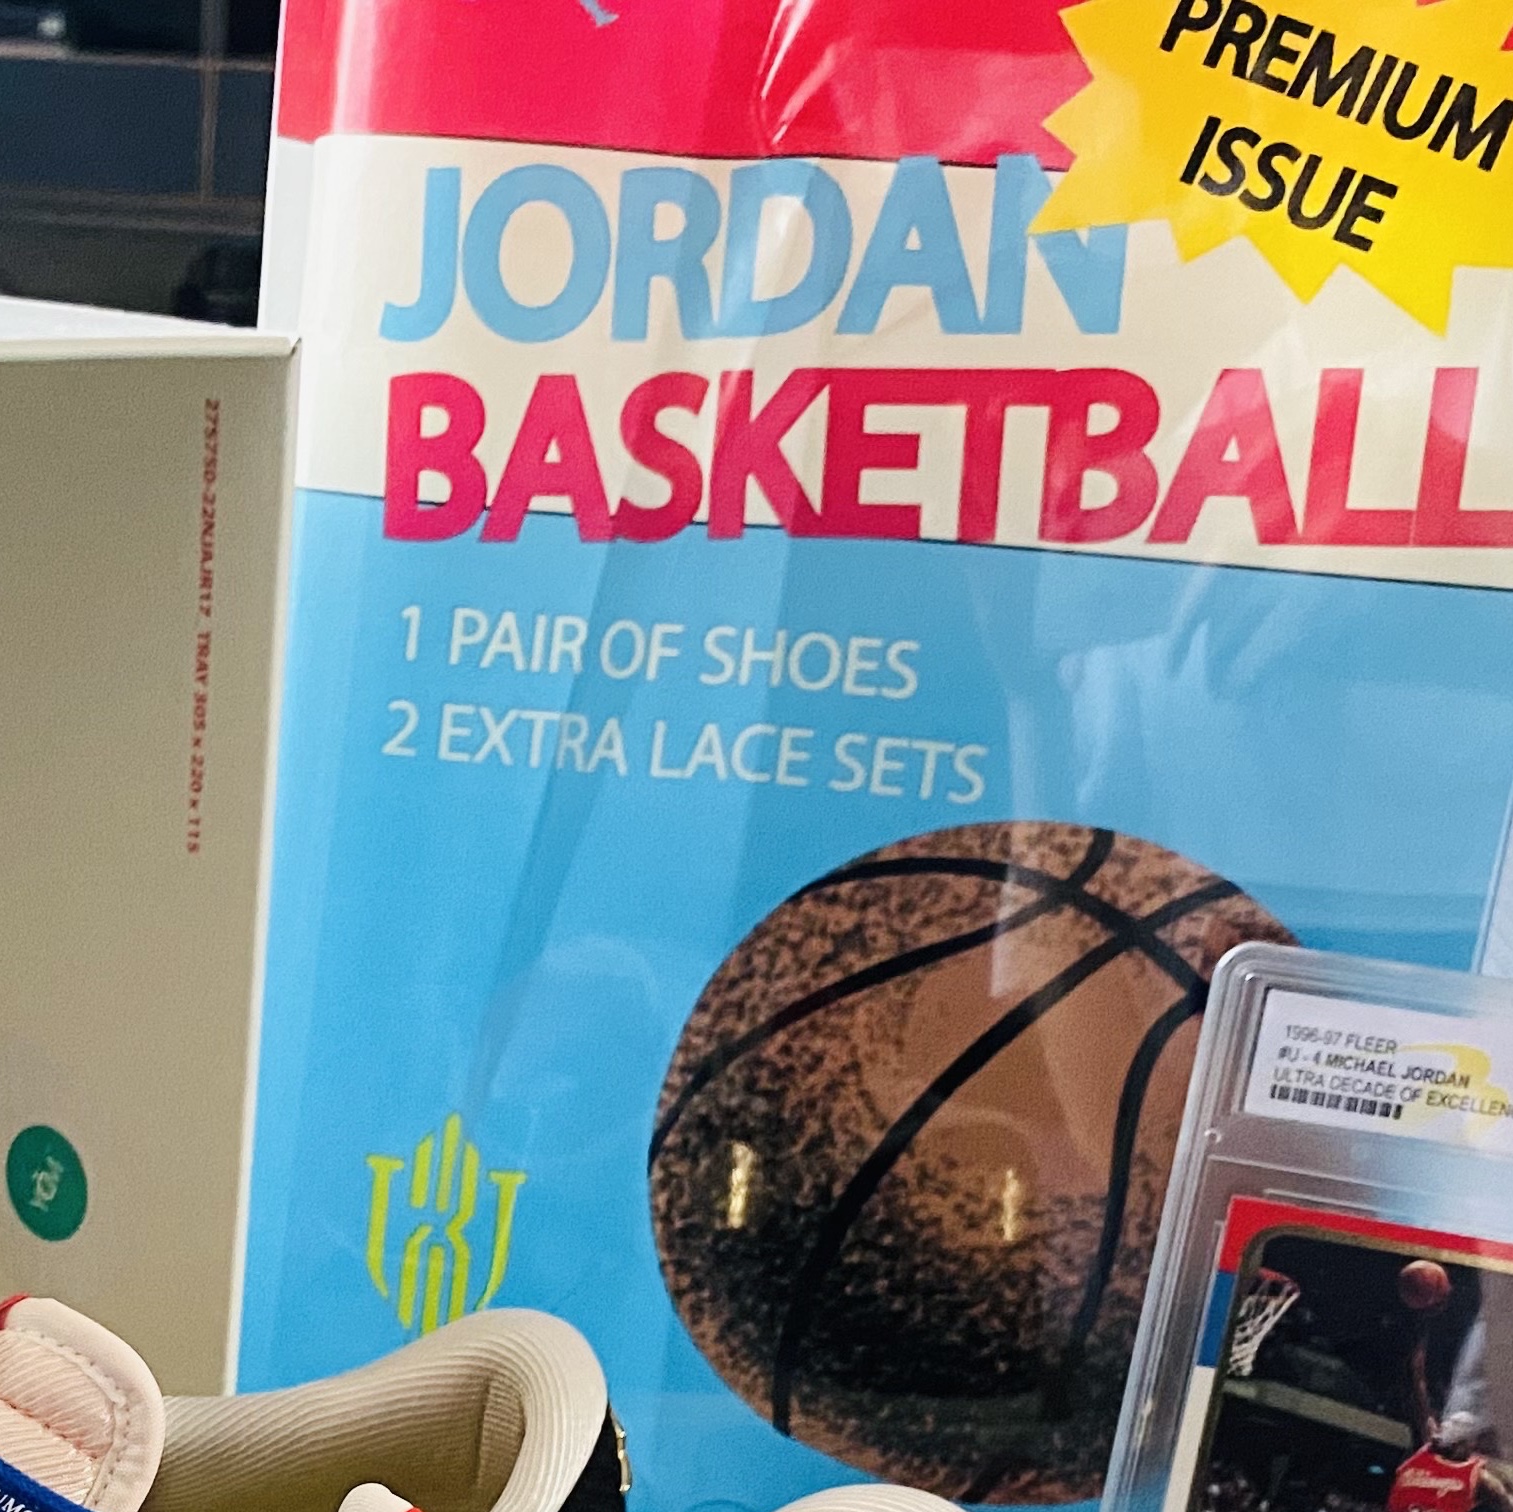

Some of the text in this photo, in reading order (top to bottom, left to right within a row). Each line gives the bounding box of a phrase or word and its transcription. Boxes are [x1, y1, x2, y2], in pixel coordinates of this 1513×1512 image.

[1159, 0, 1513, 172] PREMIUM
[1179, 115, 1399, 252] ISSUE
[379, 153, 1127, 342] JORDAN
[382, 366, 1513, 546] BASKETBALL
[194, 631, 212, 685] TRAY
[400, 606, 921, 699] 1 PAIR OF SHOES
[193, 691, 208, 731] 305
[190, 754, 205, 793] 220
[381, 700, 989, 804] 2 EXTRA LACE SETS
[187, 817, 201, 853] 115
[1344, 1033, 1398, 1054] FLEER
[1272, 1067, 1325, 1087] ULTRA
[1328, 1075, 1397, 1100] DECADE
[1399, 1086, 1422, 1103] OF
[1325, 1054, 1397, 1079] MICHAEL
[1400, 1066, 1471, 1089] JORDAN
